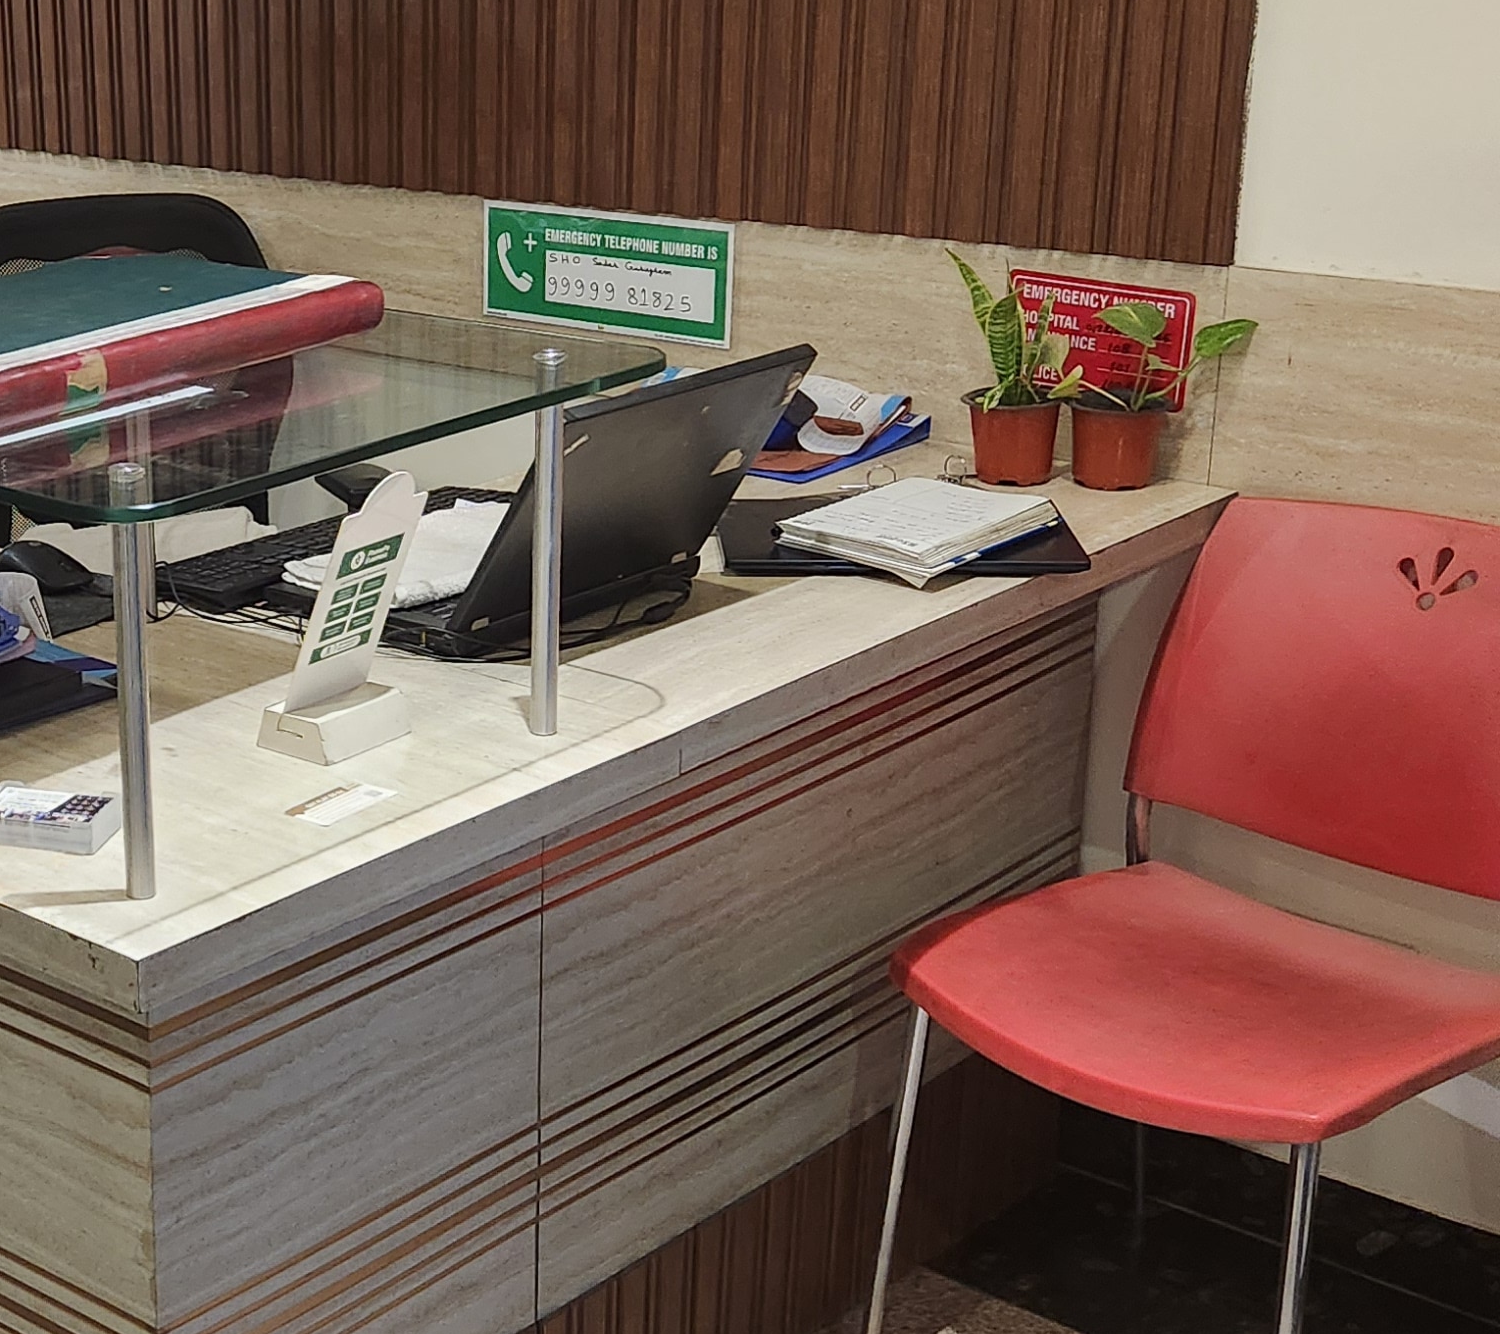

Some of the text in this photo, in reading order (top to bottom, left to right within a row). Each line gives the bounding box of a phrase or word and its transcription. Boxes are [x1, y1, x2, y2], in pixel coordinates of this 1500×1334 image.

[545, 228, 718, 260] EMERGENCY TELEPHONE NUMBER IS
[548, 276, 692, 313] 99999 81825
[1023, 283, 1109, 308] EMERGENCY
[1023, 310, 1080, 331] HOPITAL
